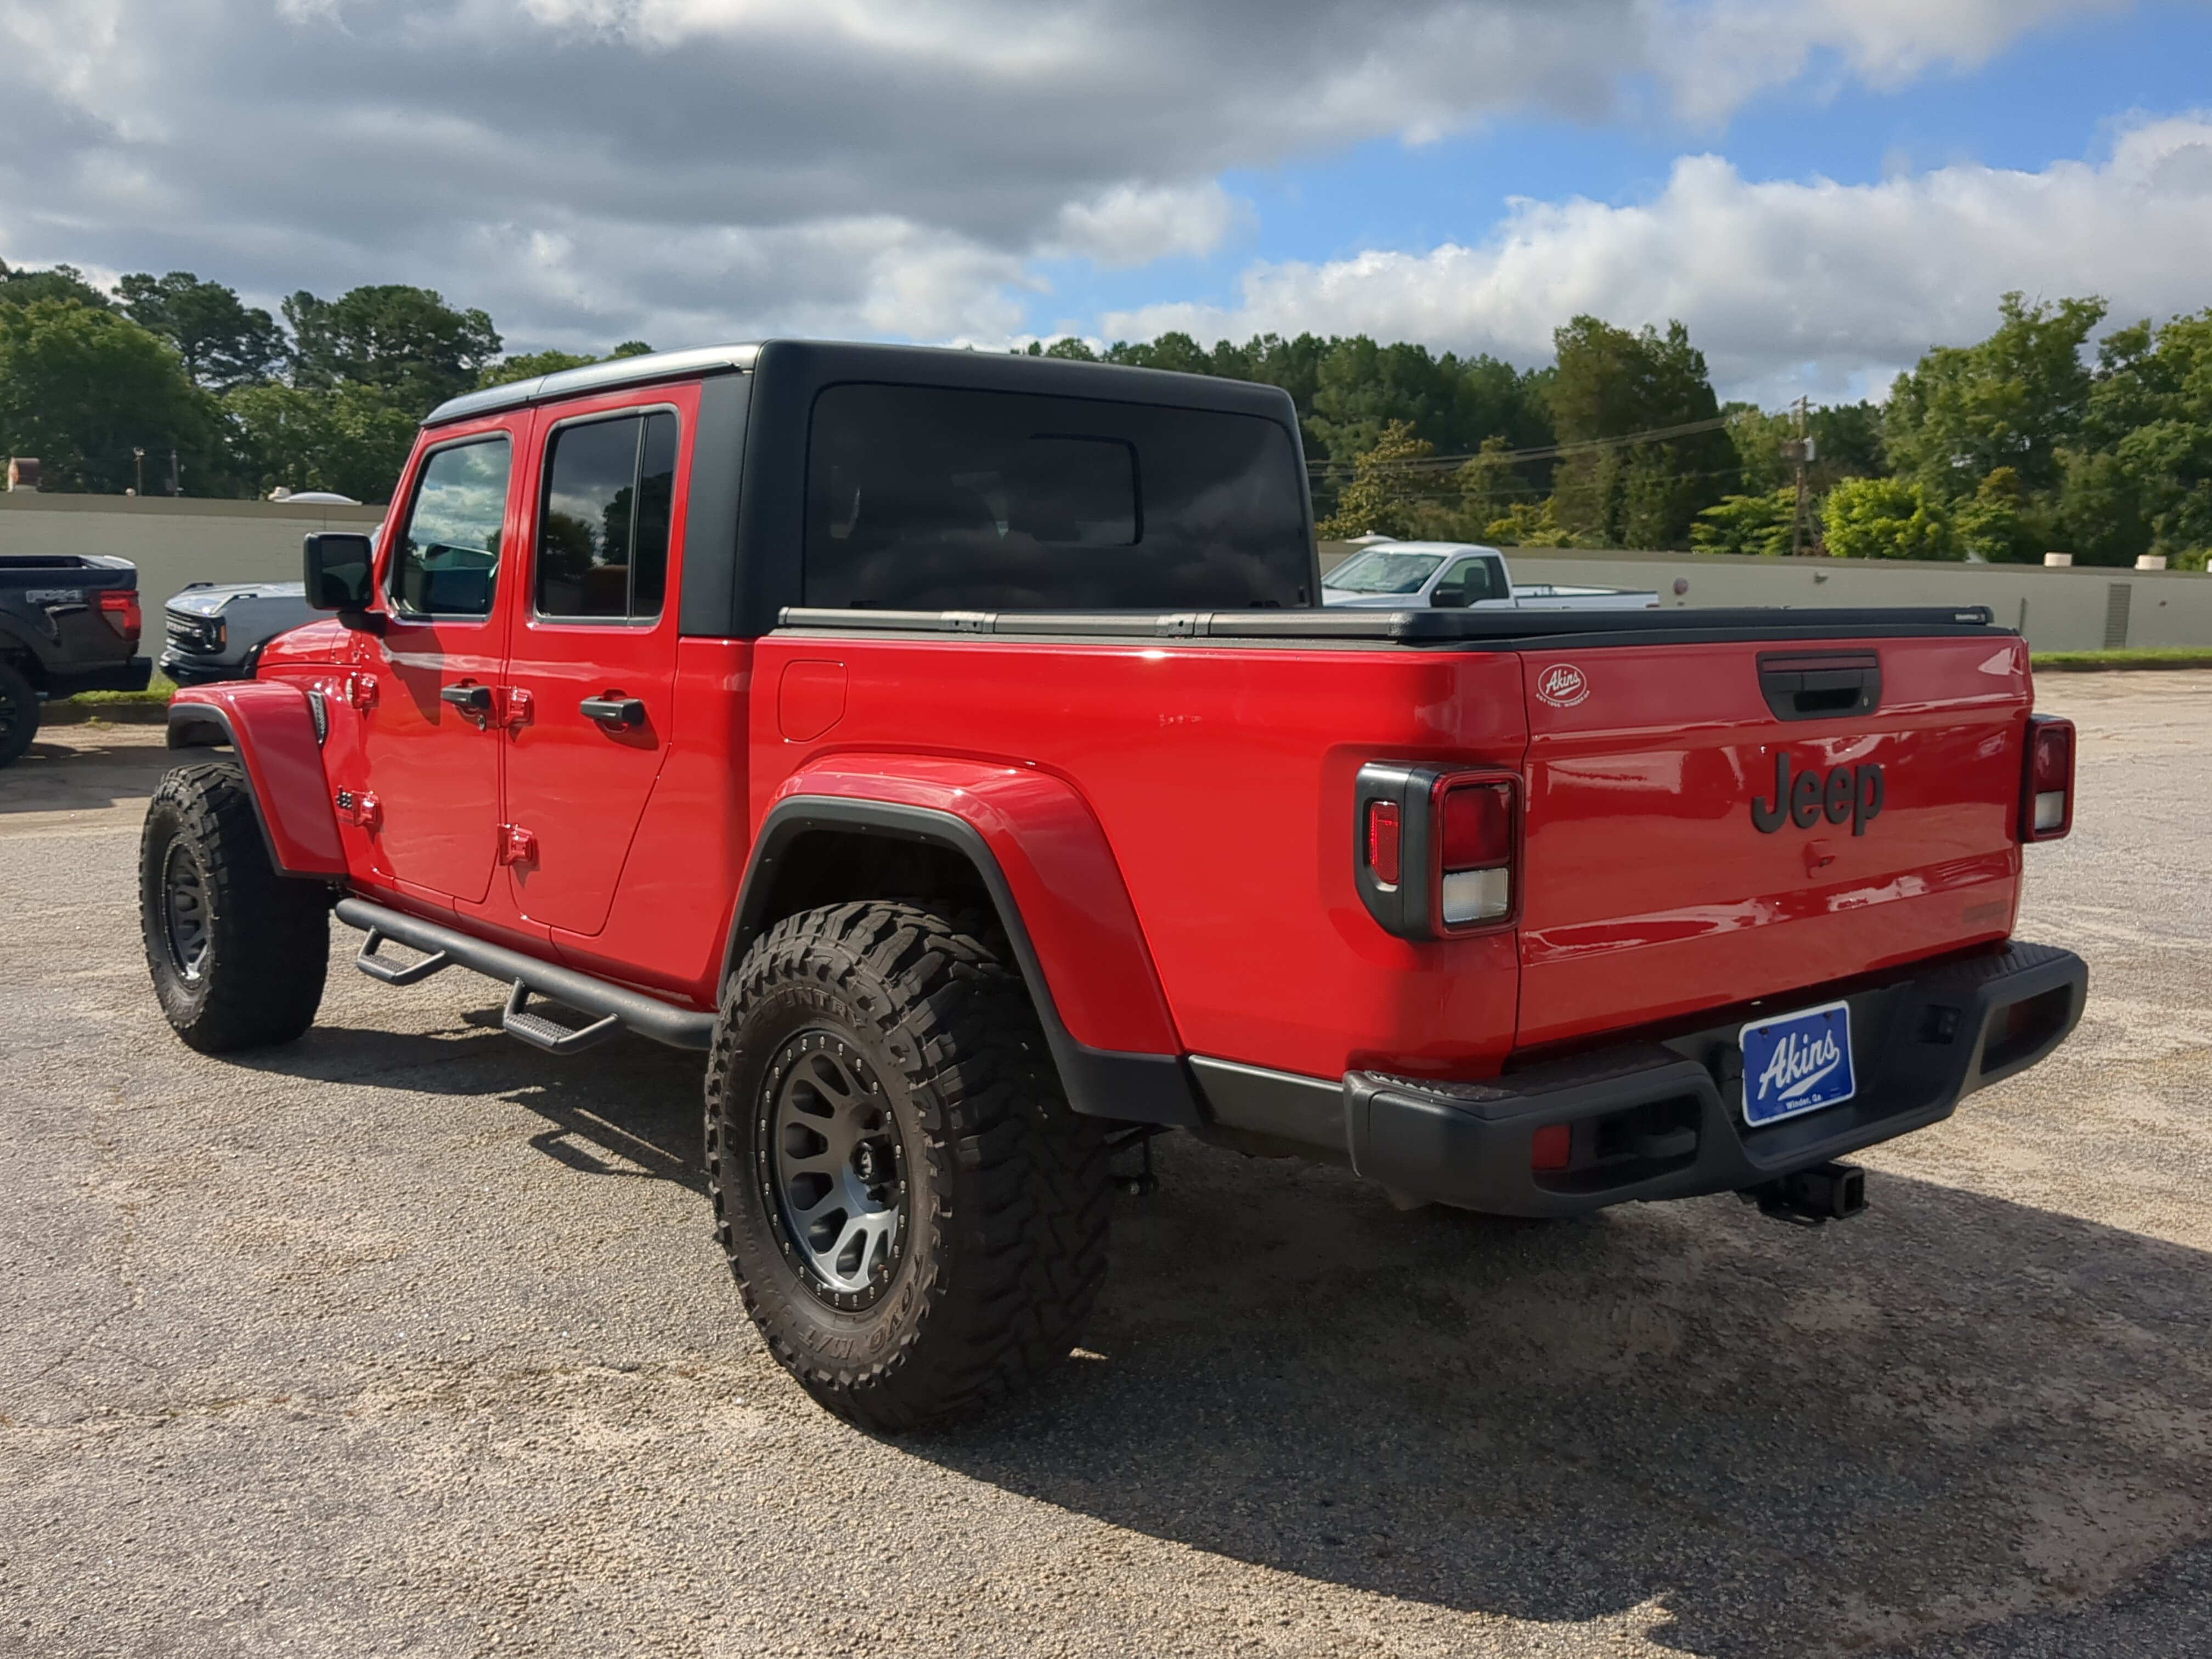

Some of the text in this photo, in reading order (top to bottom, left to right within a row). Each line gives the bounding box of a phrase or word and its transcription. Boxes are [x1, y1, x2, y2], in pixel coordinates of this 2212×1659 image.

[1545, 669, 1581, 695] Akins
[1751, 752, 1884, 836] Jeep
[1757, 1029, 1839, 1100] Akins
